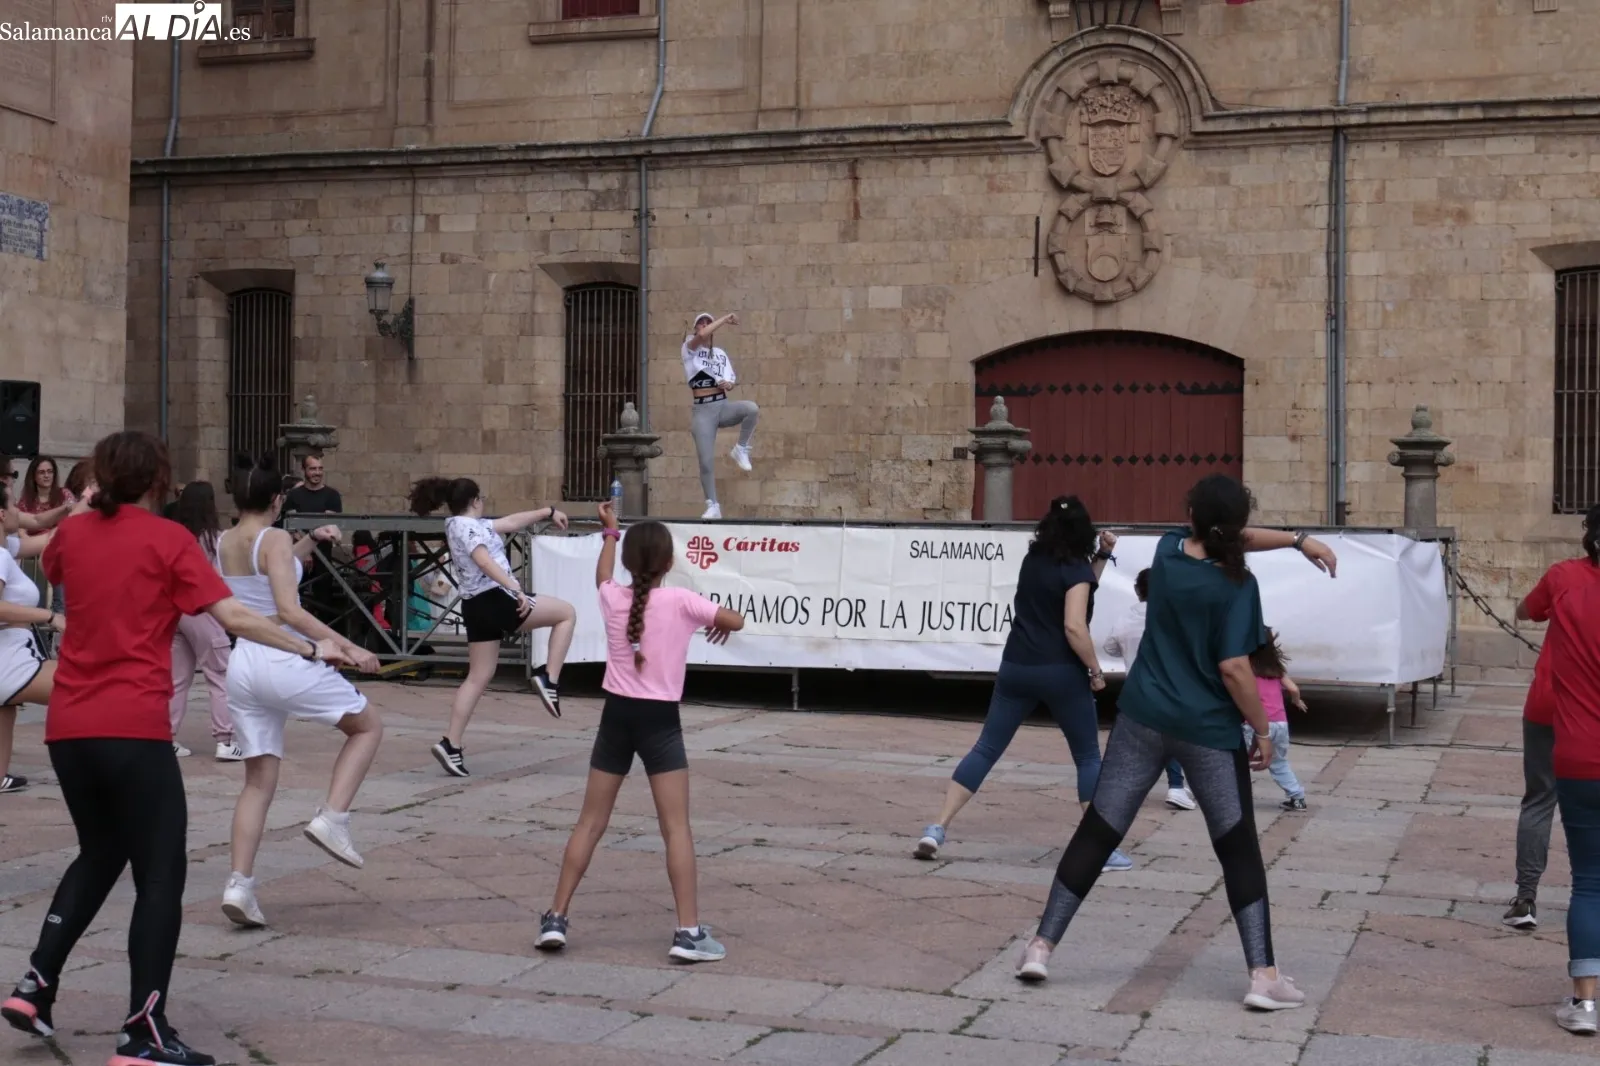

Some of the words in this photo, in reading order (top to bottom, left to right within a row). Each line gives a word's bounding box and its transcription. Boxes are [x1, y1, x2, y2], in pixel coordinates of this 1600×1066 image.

[723, 536, 799, 553] Cáritas
[910, 540, 1005, 561] SALAMANCA
[821, 596, 866, 629] POR
[880, 599, 907, 629] LA
[918, 600, 1013, 636] JUSTICIA
